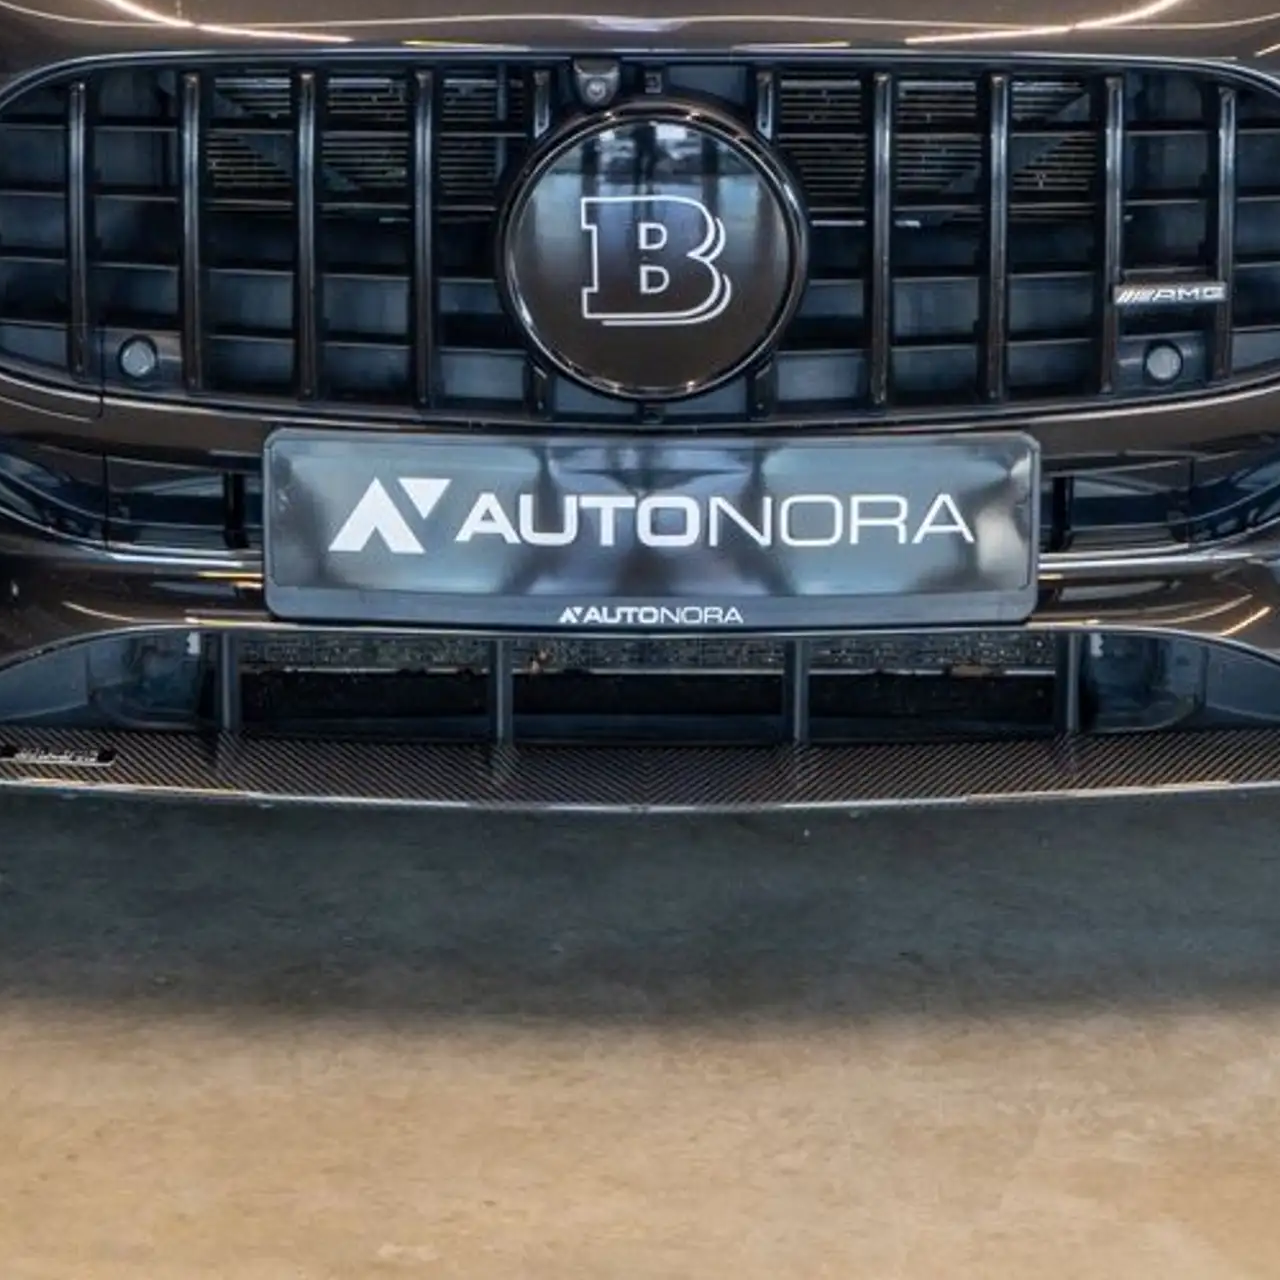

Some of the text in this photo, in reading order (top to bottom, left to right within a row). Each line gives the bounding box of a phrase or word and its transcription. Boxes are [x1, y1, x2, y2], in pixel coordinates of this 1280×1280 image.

[580, 194, 733, 327] B
[455, 493, 975, 547] AUTONORA
[582, 606, 744, 625] AUTONORA
